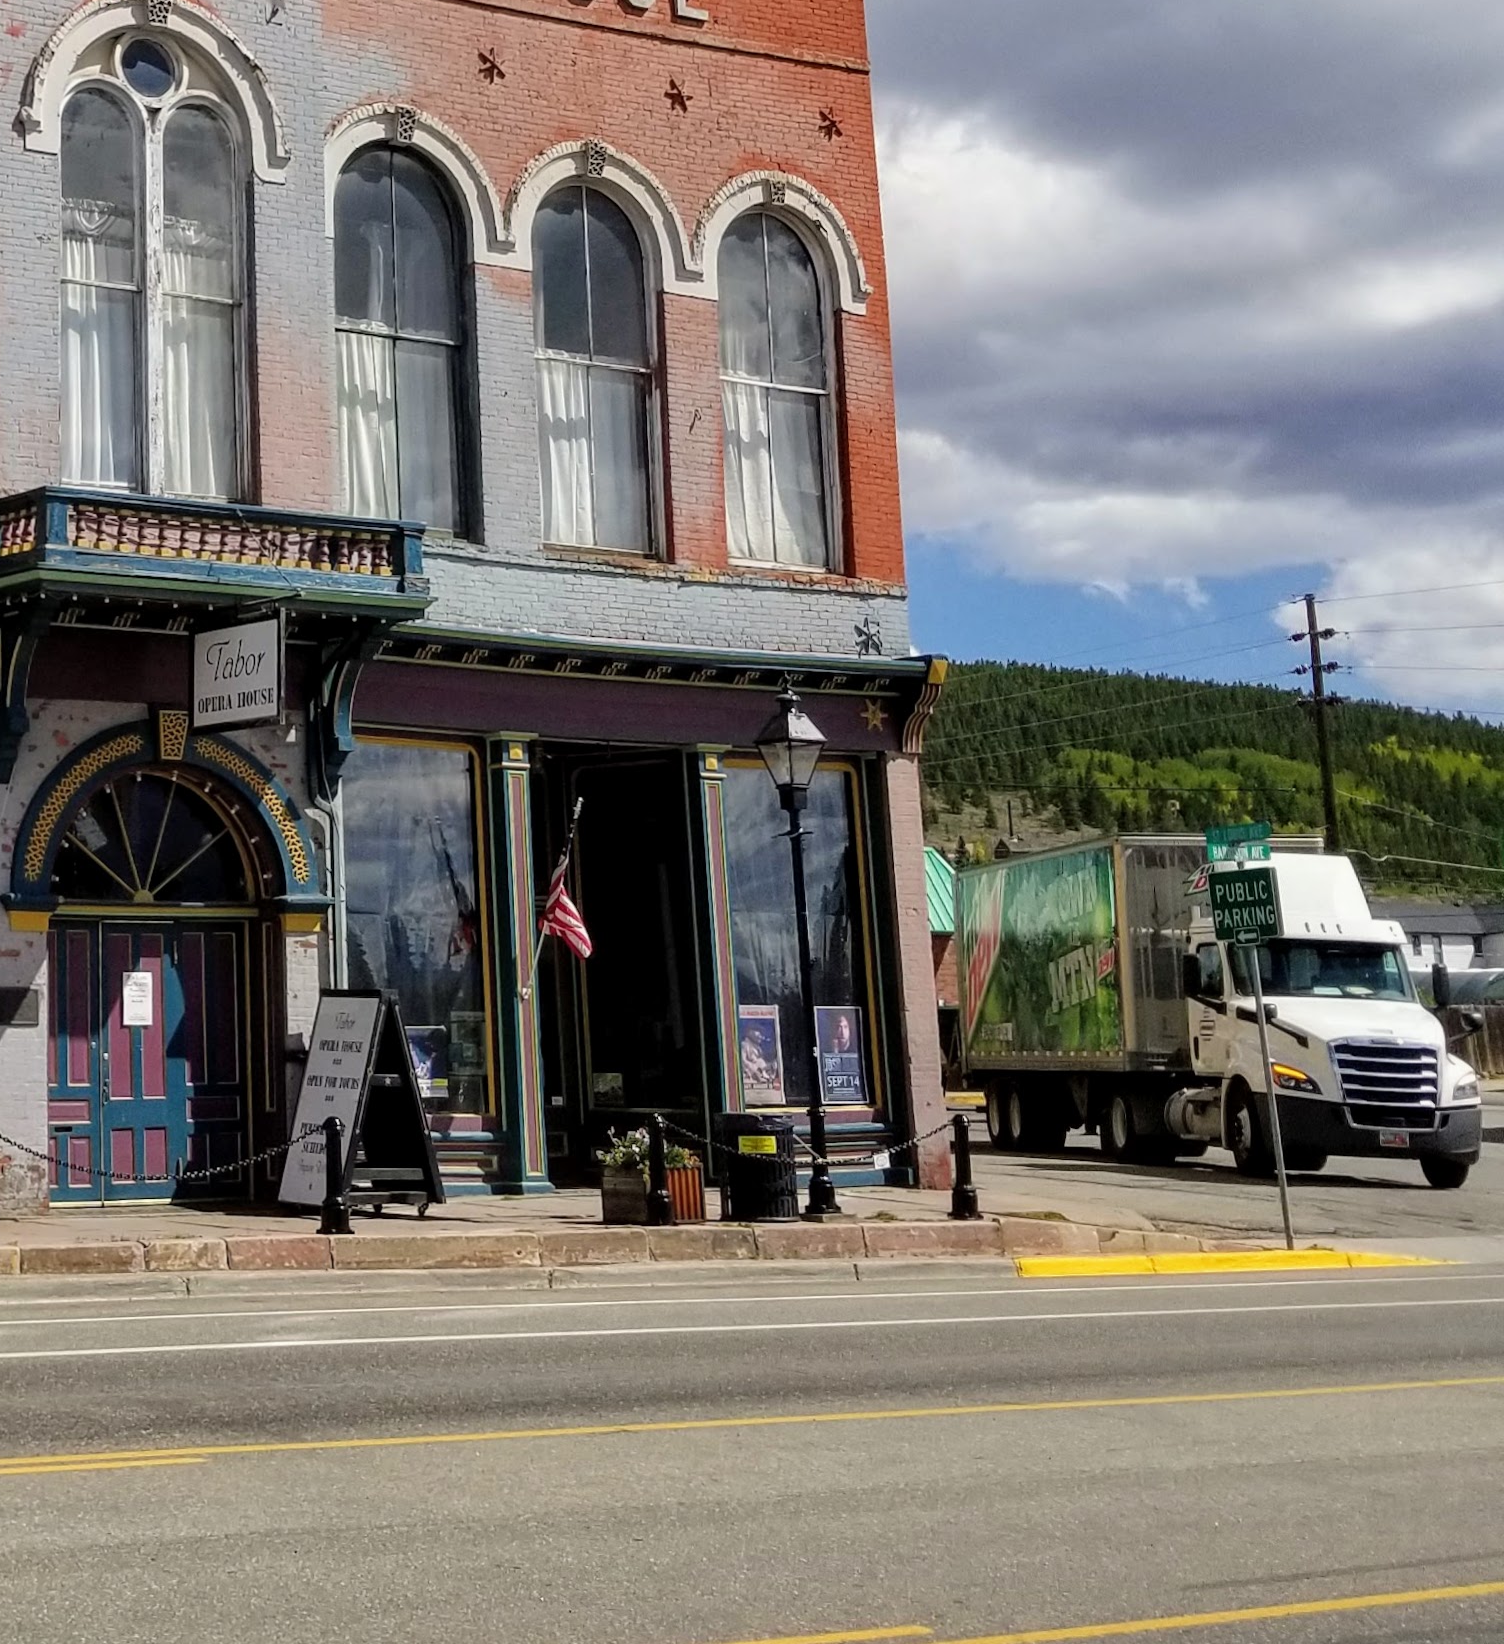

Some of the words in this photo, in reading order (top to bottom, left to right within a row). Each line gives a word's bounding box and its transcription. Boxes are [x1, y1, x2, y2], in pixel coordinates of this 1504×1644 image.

[206, 638, 266, 682] Tabor
[197, 694, 233, 714] OPERA
[237, 687, 274, 708] HOUSE
[1215, 879, 1268, 903] PUBLIC
[1214, 905, 1275, 929] PARKING
[1049, 944, 1097, 1014] MTN
[827, 1075, 848, 1087] SEPT
[849, 1075, 860, 1087] 14
